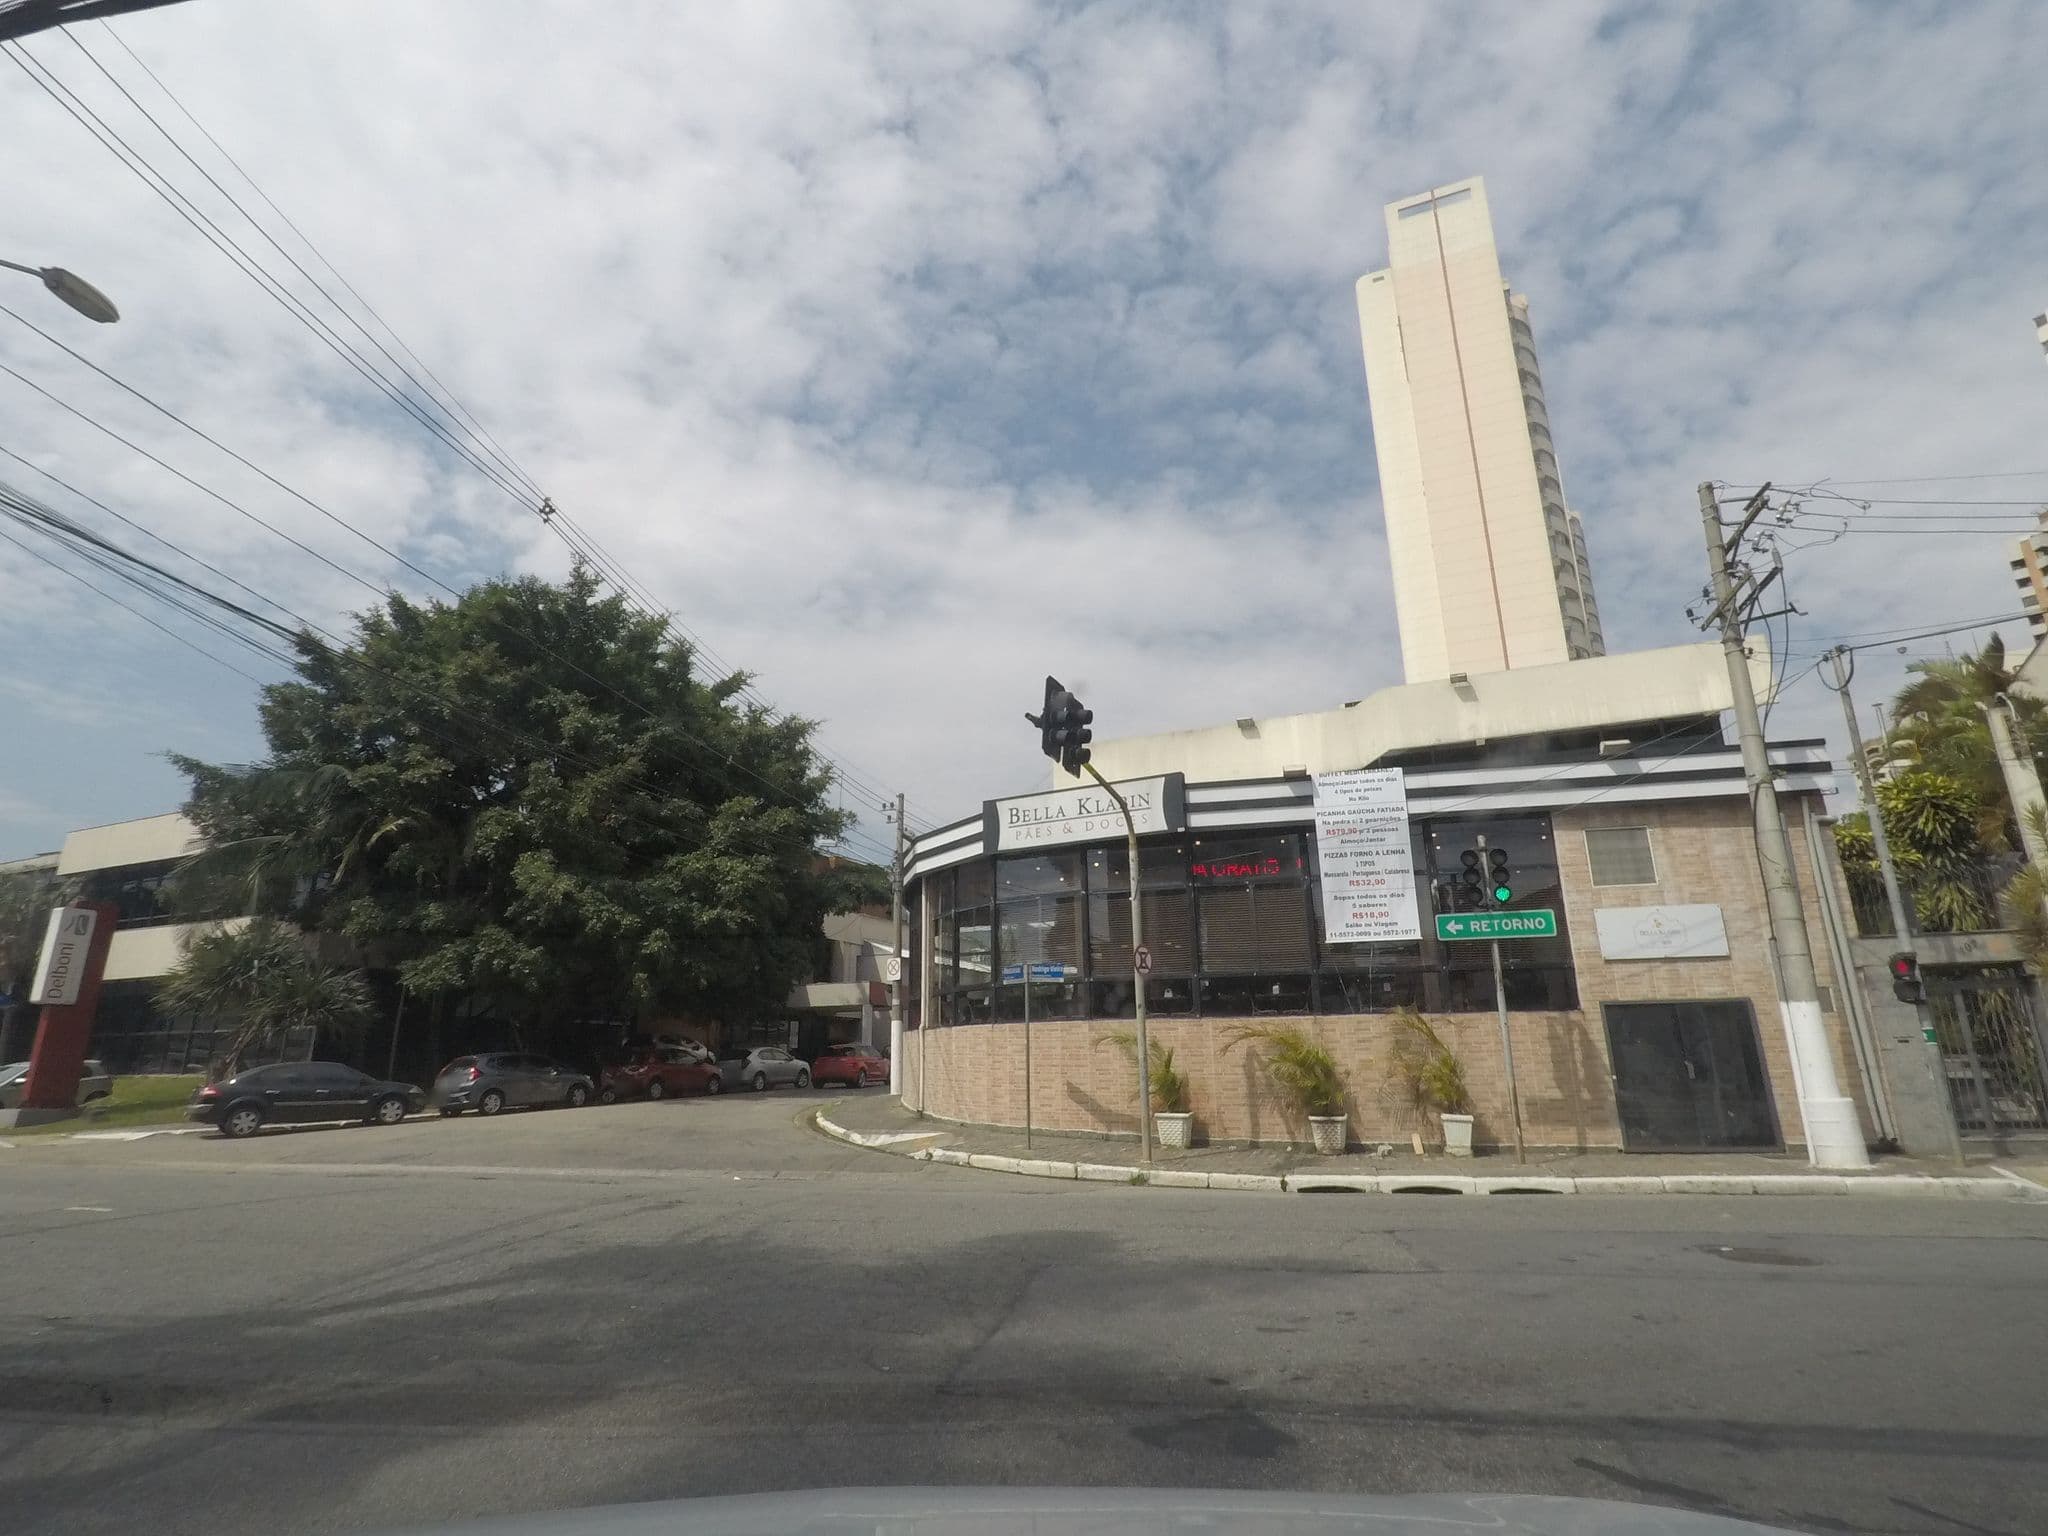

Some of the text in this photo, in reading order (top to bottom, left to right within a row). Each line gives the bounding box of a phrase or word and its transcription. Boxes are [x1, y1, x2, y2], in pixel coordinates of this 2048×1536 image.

[1008, 805, 1066, 825] BELLA
[1317, 810, 1346, 818] PICANHA
[1377, 806, 1405, 814] FATIADA
[1062, 822, 1073, 834] &
[1323, 851, 1348, 859] PIZZAS
[1350, 850, 1373, 858] FORNO
[1382, 848, 1405, 856] LENHA
[1349, 878, 1386, 887] R$32,90
[1469, 917, 1546, 932] RETORNO
[47, 942, 77, 999] Delboni
